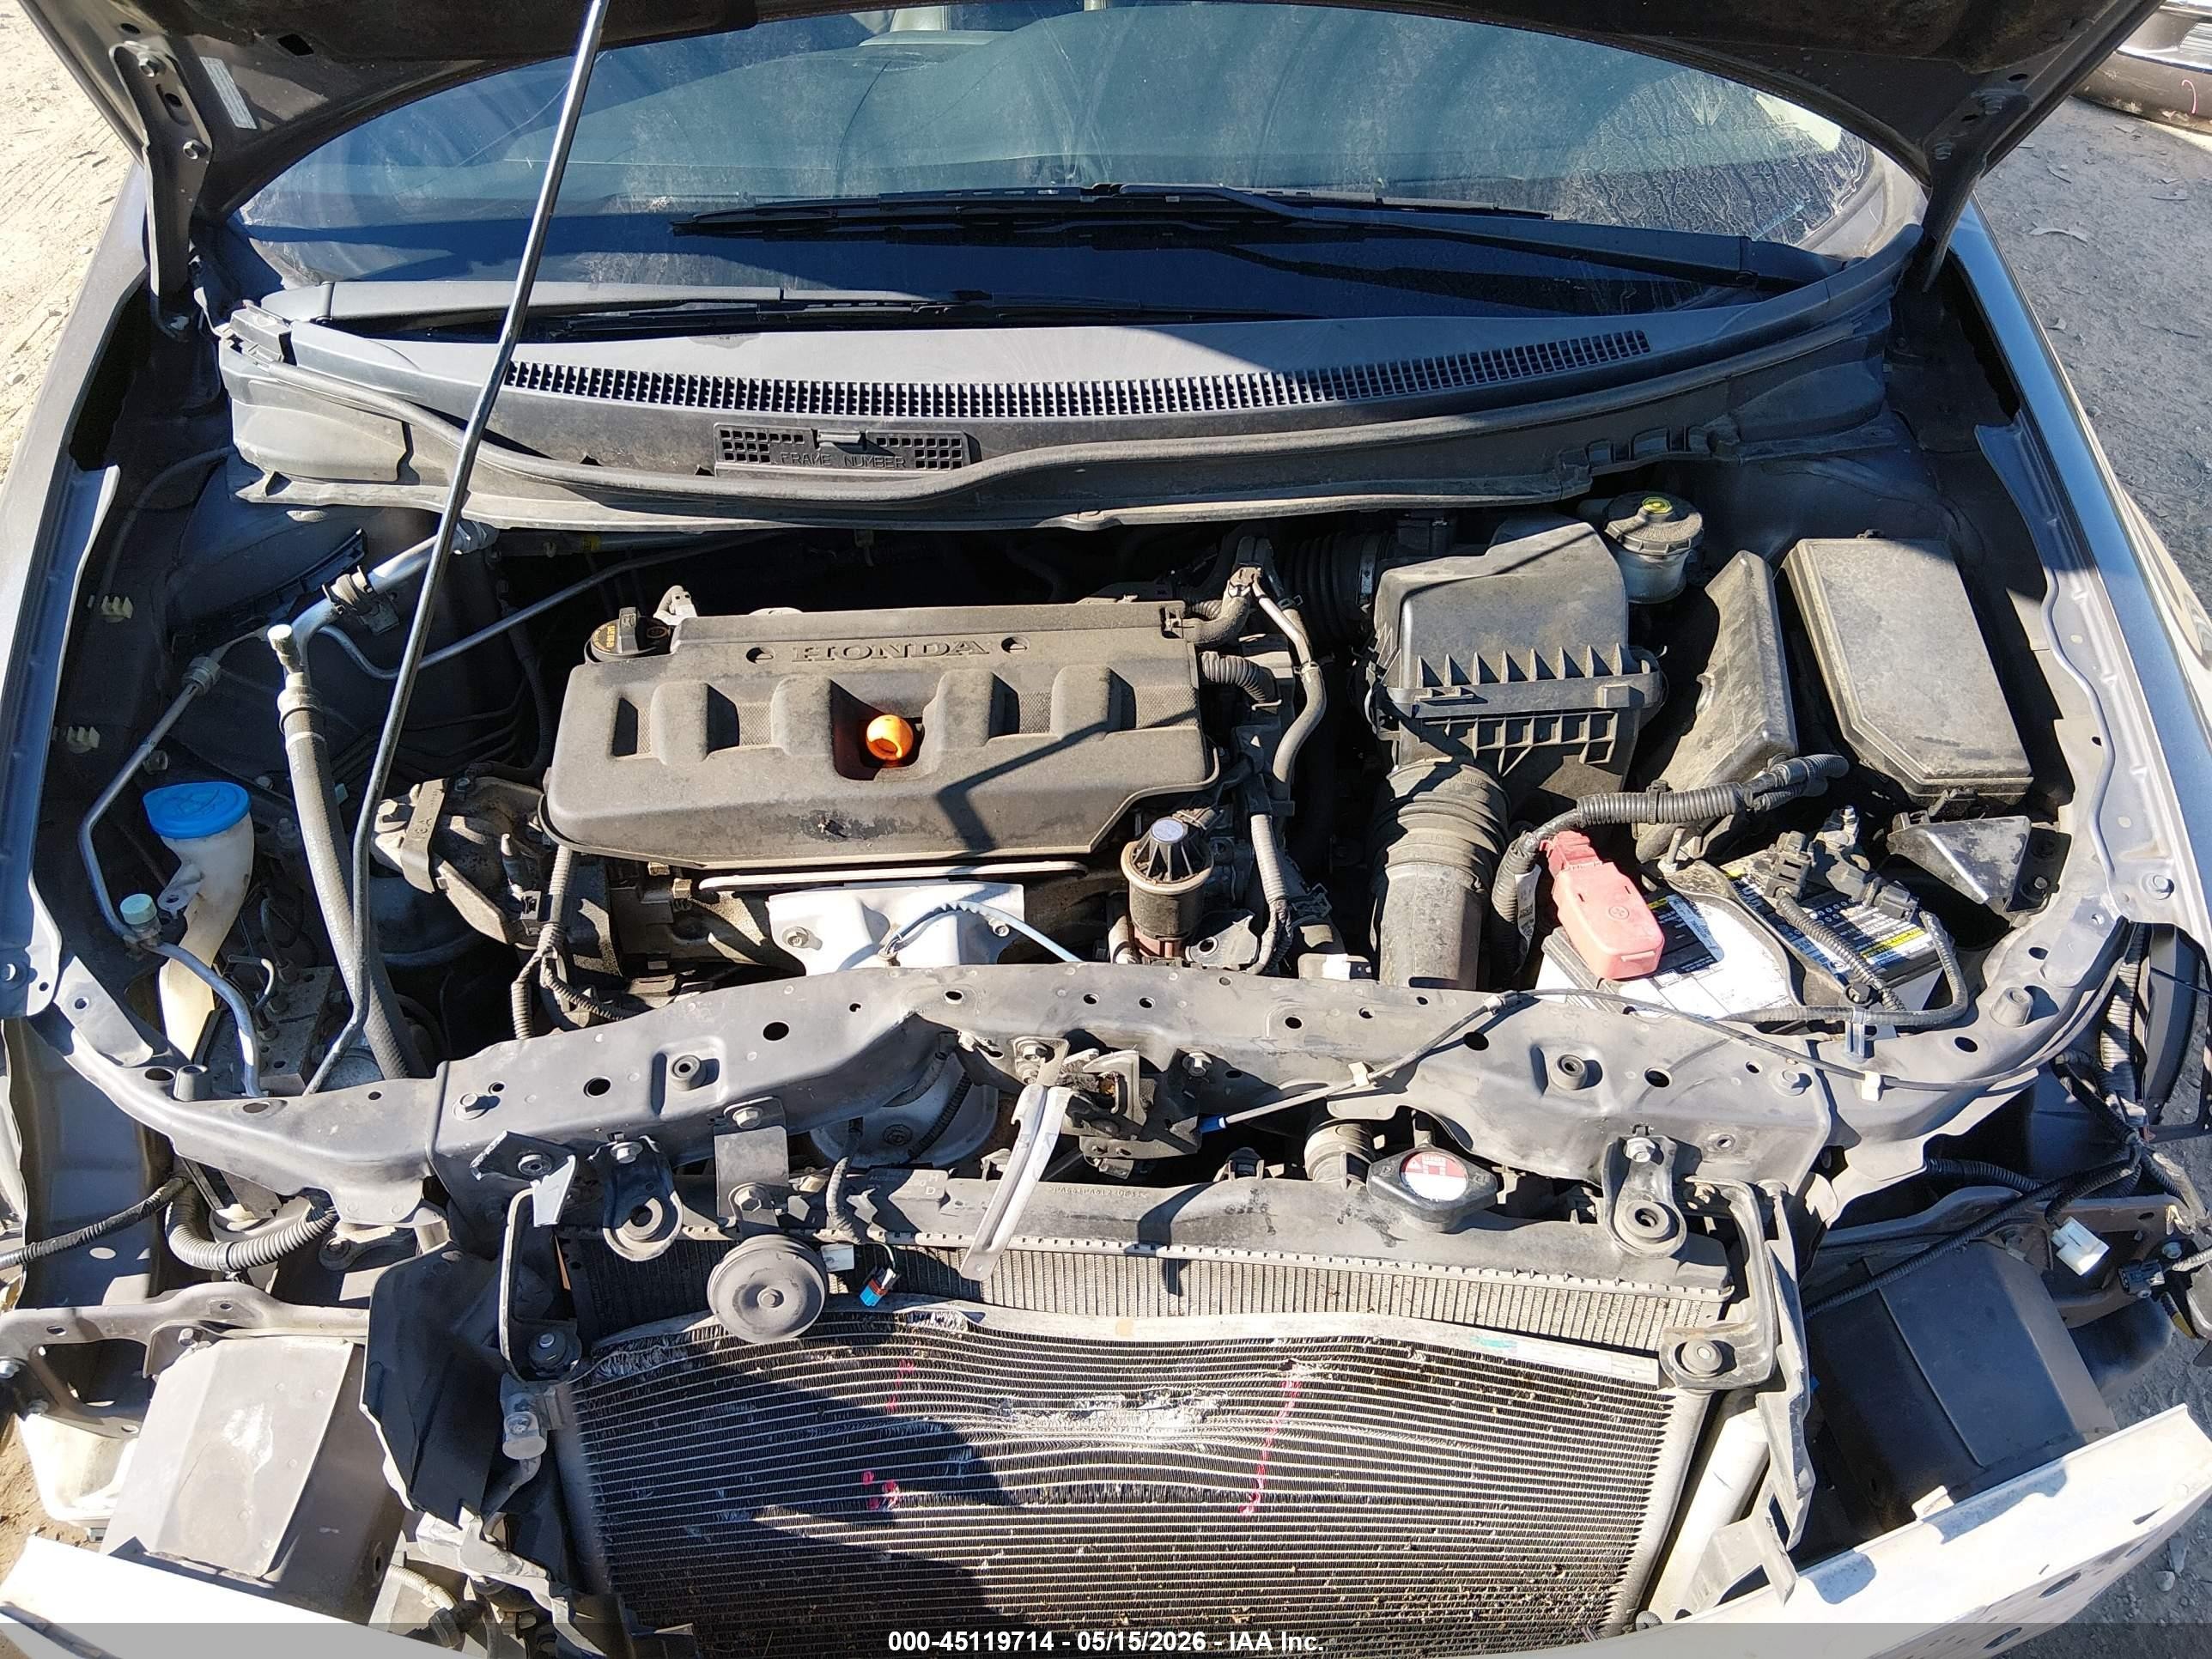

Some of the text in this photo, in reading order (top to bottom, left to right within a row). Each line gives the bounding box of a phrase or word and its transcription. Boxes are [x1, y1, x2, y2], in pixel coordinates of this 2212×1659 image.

[780, 452, 907, 469] FRAME NUMBER
[792, 641, 990, 662] HONDA
